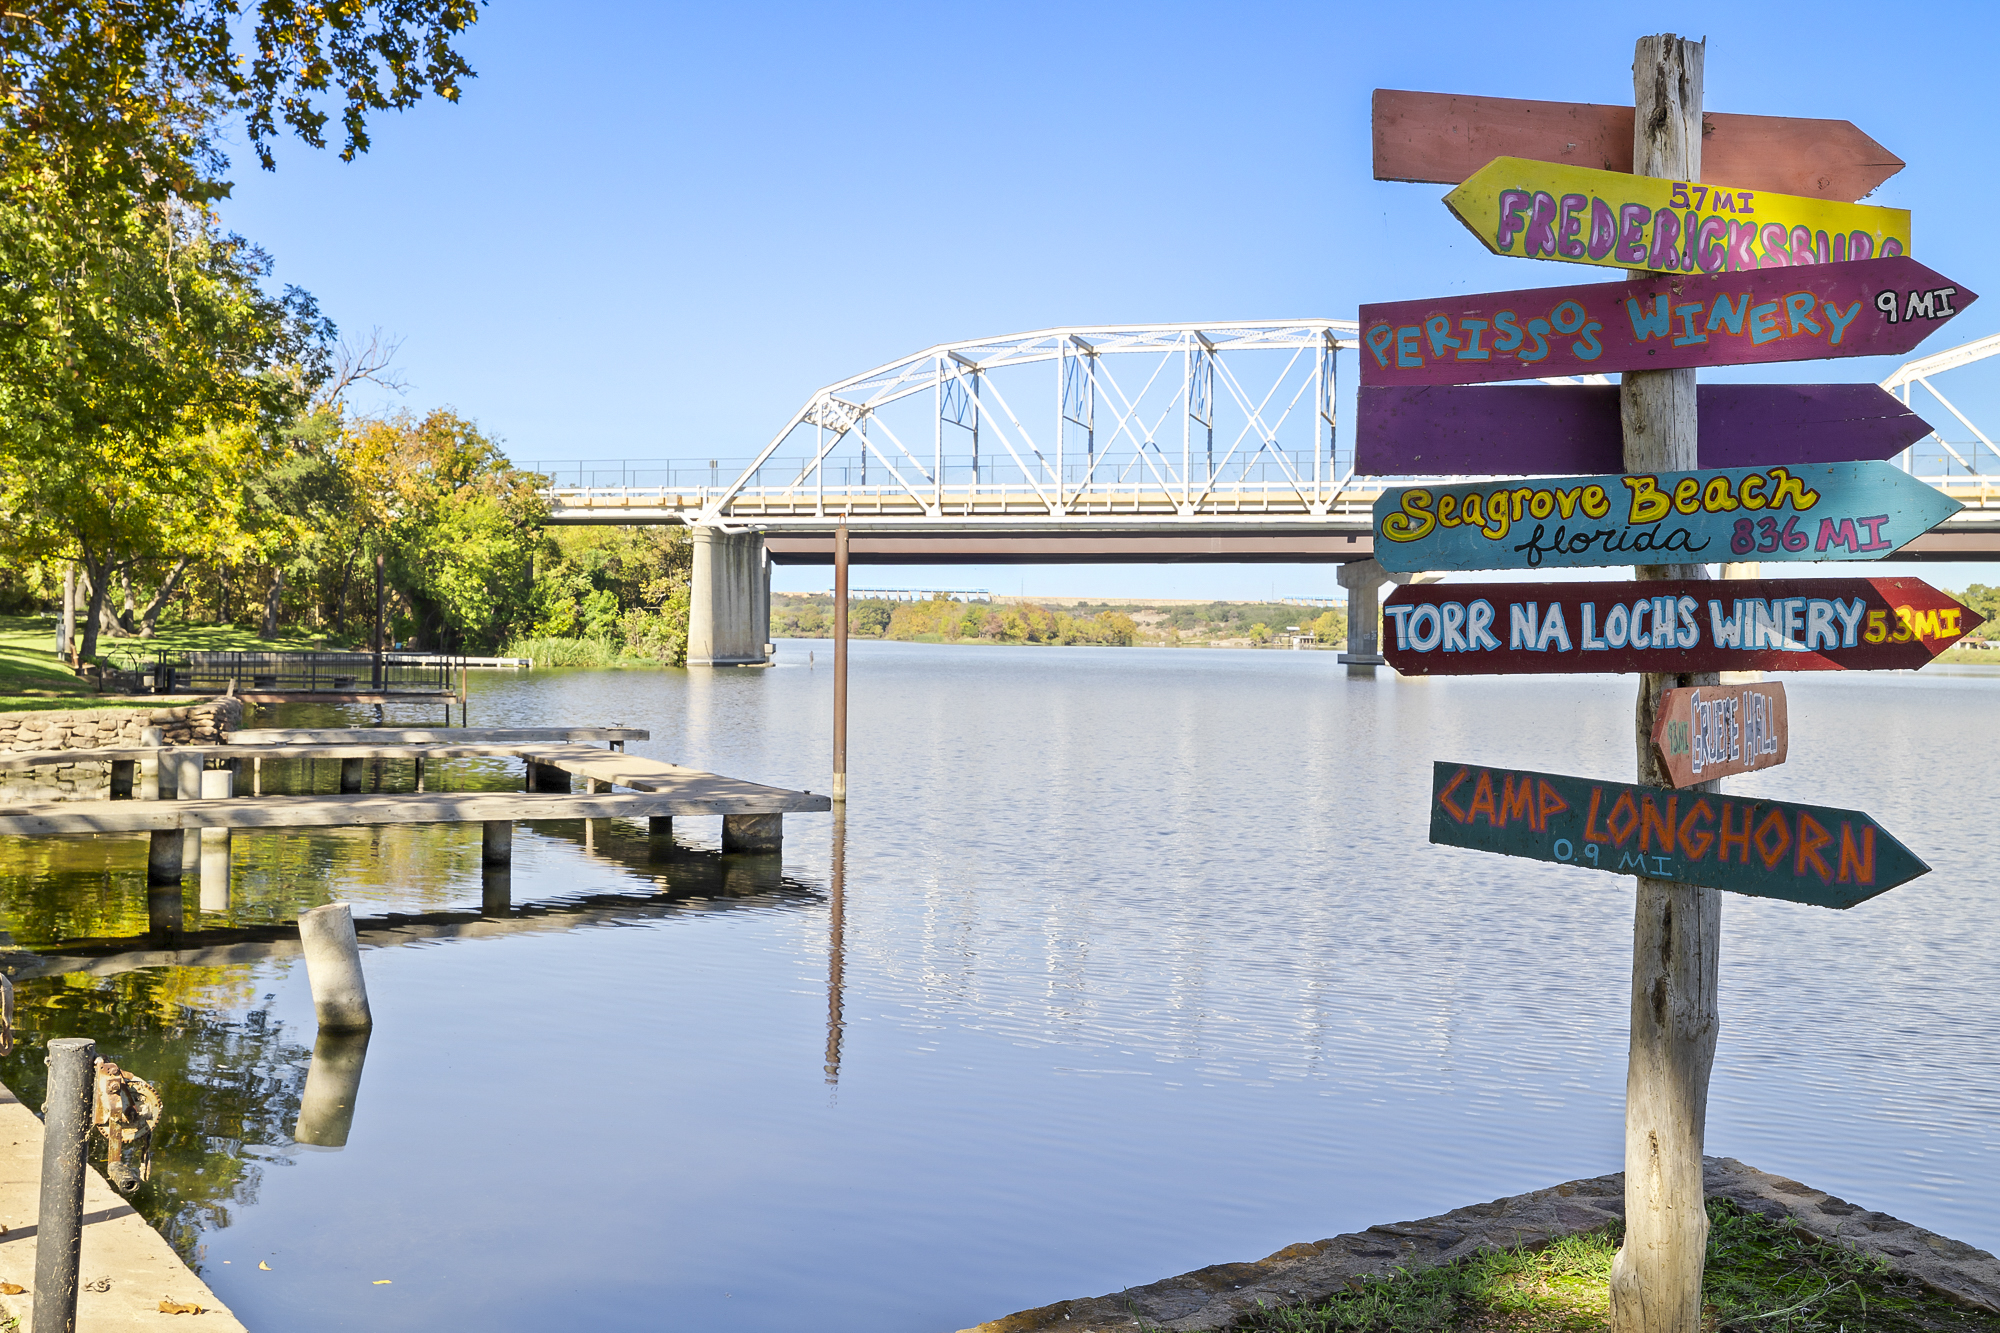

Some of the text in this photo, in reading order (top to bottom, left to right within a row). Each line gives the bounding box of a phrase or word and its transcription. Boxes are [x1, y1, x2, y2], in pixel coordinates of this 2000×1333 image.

[1669, 182, 1755, 214] 57 MI
[1365, 287, 1958, 370] PERISSOS WINERY 9 MI
[1381, 467, 1821, 542] Seagrove Beach
[1730, 517, 1809, 556] 836
[1814, 513, 1894, 554] MI
[1385, 601, 1502, 653] TORR
[1509, 601, 1571, 653] NA
[1580, 596, 1700, 651] LOCHS
[1708, 596, 1867, 652] WINERY
[1743, 690, 1778, 766] HALL
[1438, 765, 1877, 887] CAMP LONGHORN
[1554, 838, 1673, 876] 0.9 MI
